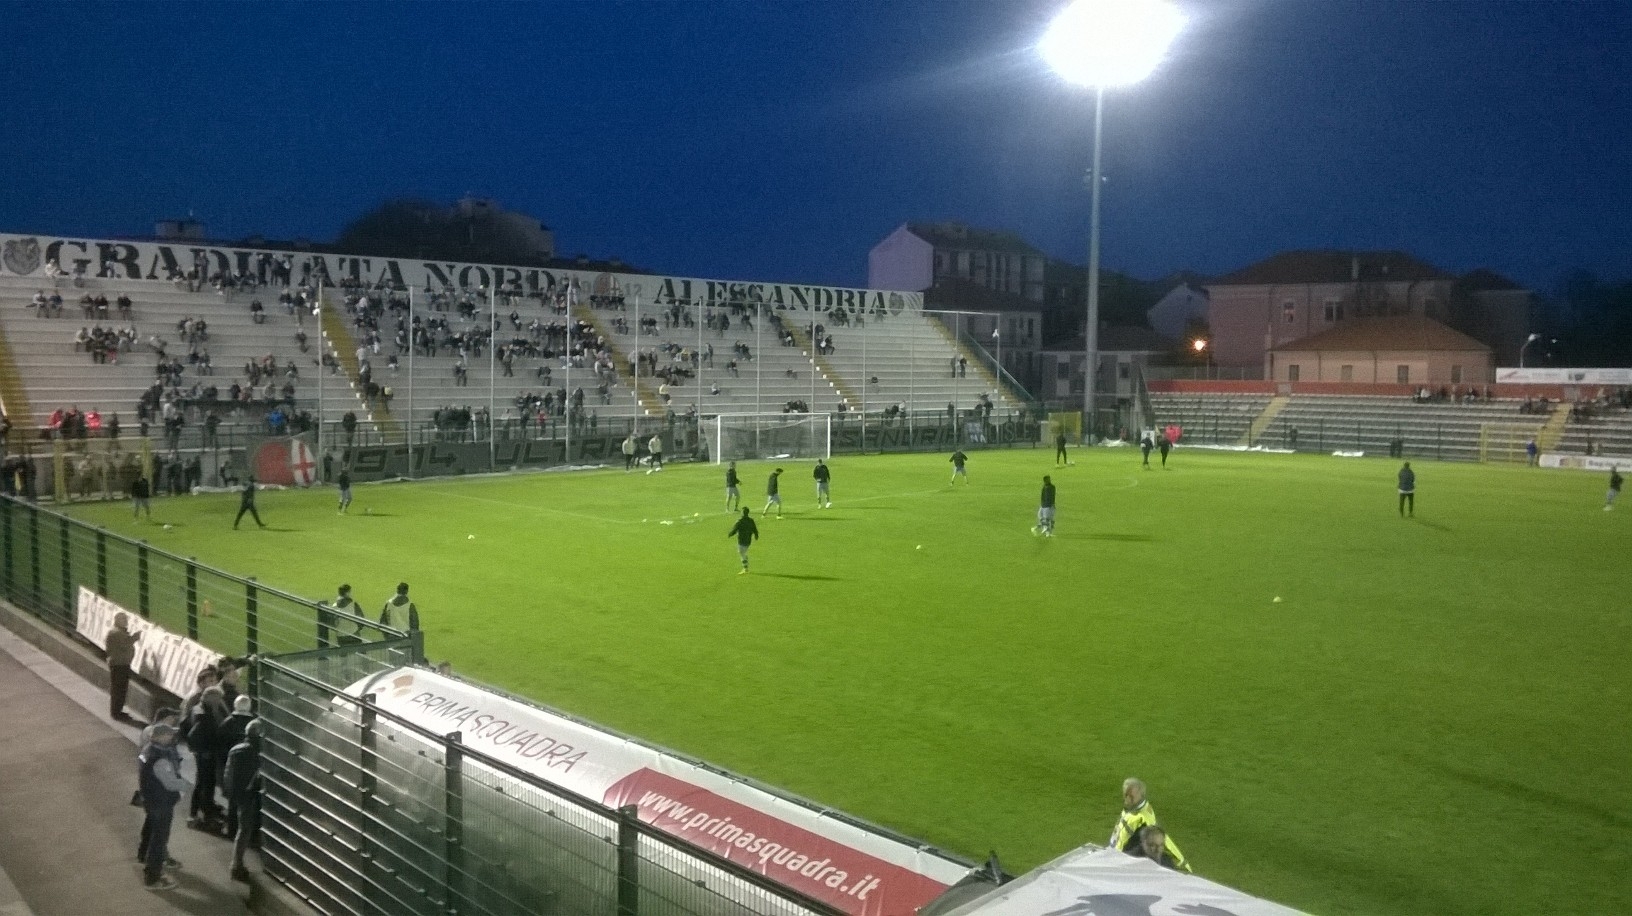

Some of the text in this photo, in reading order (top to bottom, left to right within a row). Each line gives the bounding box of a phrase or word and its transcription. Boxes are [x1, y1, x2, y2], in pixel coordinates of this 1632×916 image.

[423, 262, 557, 298] NORD
[653, 278, 889, 315] ALESSANDRIA
[411, 692, 588, 774] PRIMASQUADRA
[637, 789, 882, 901] www.primasquadra.it
